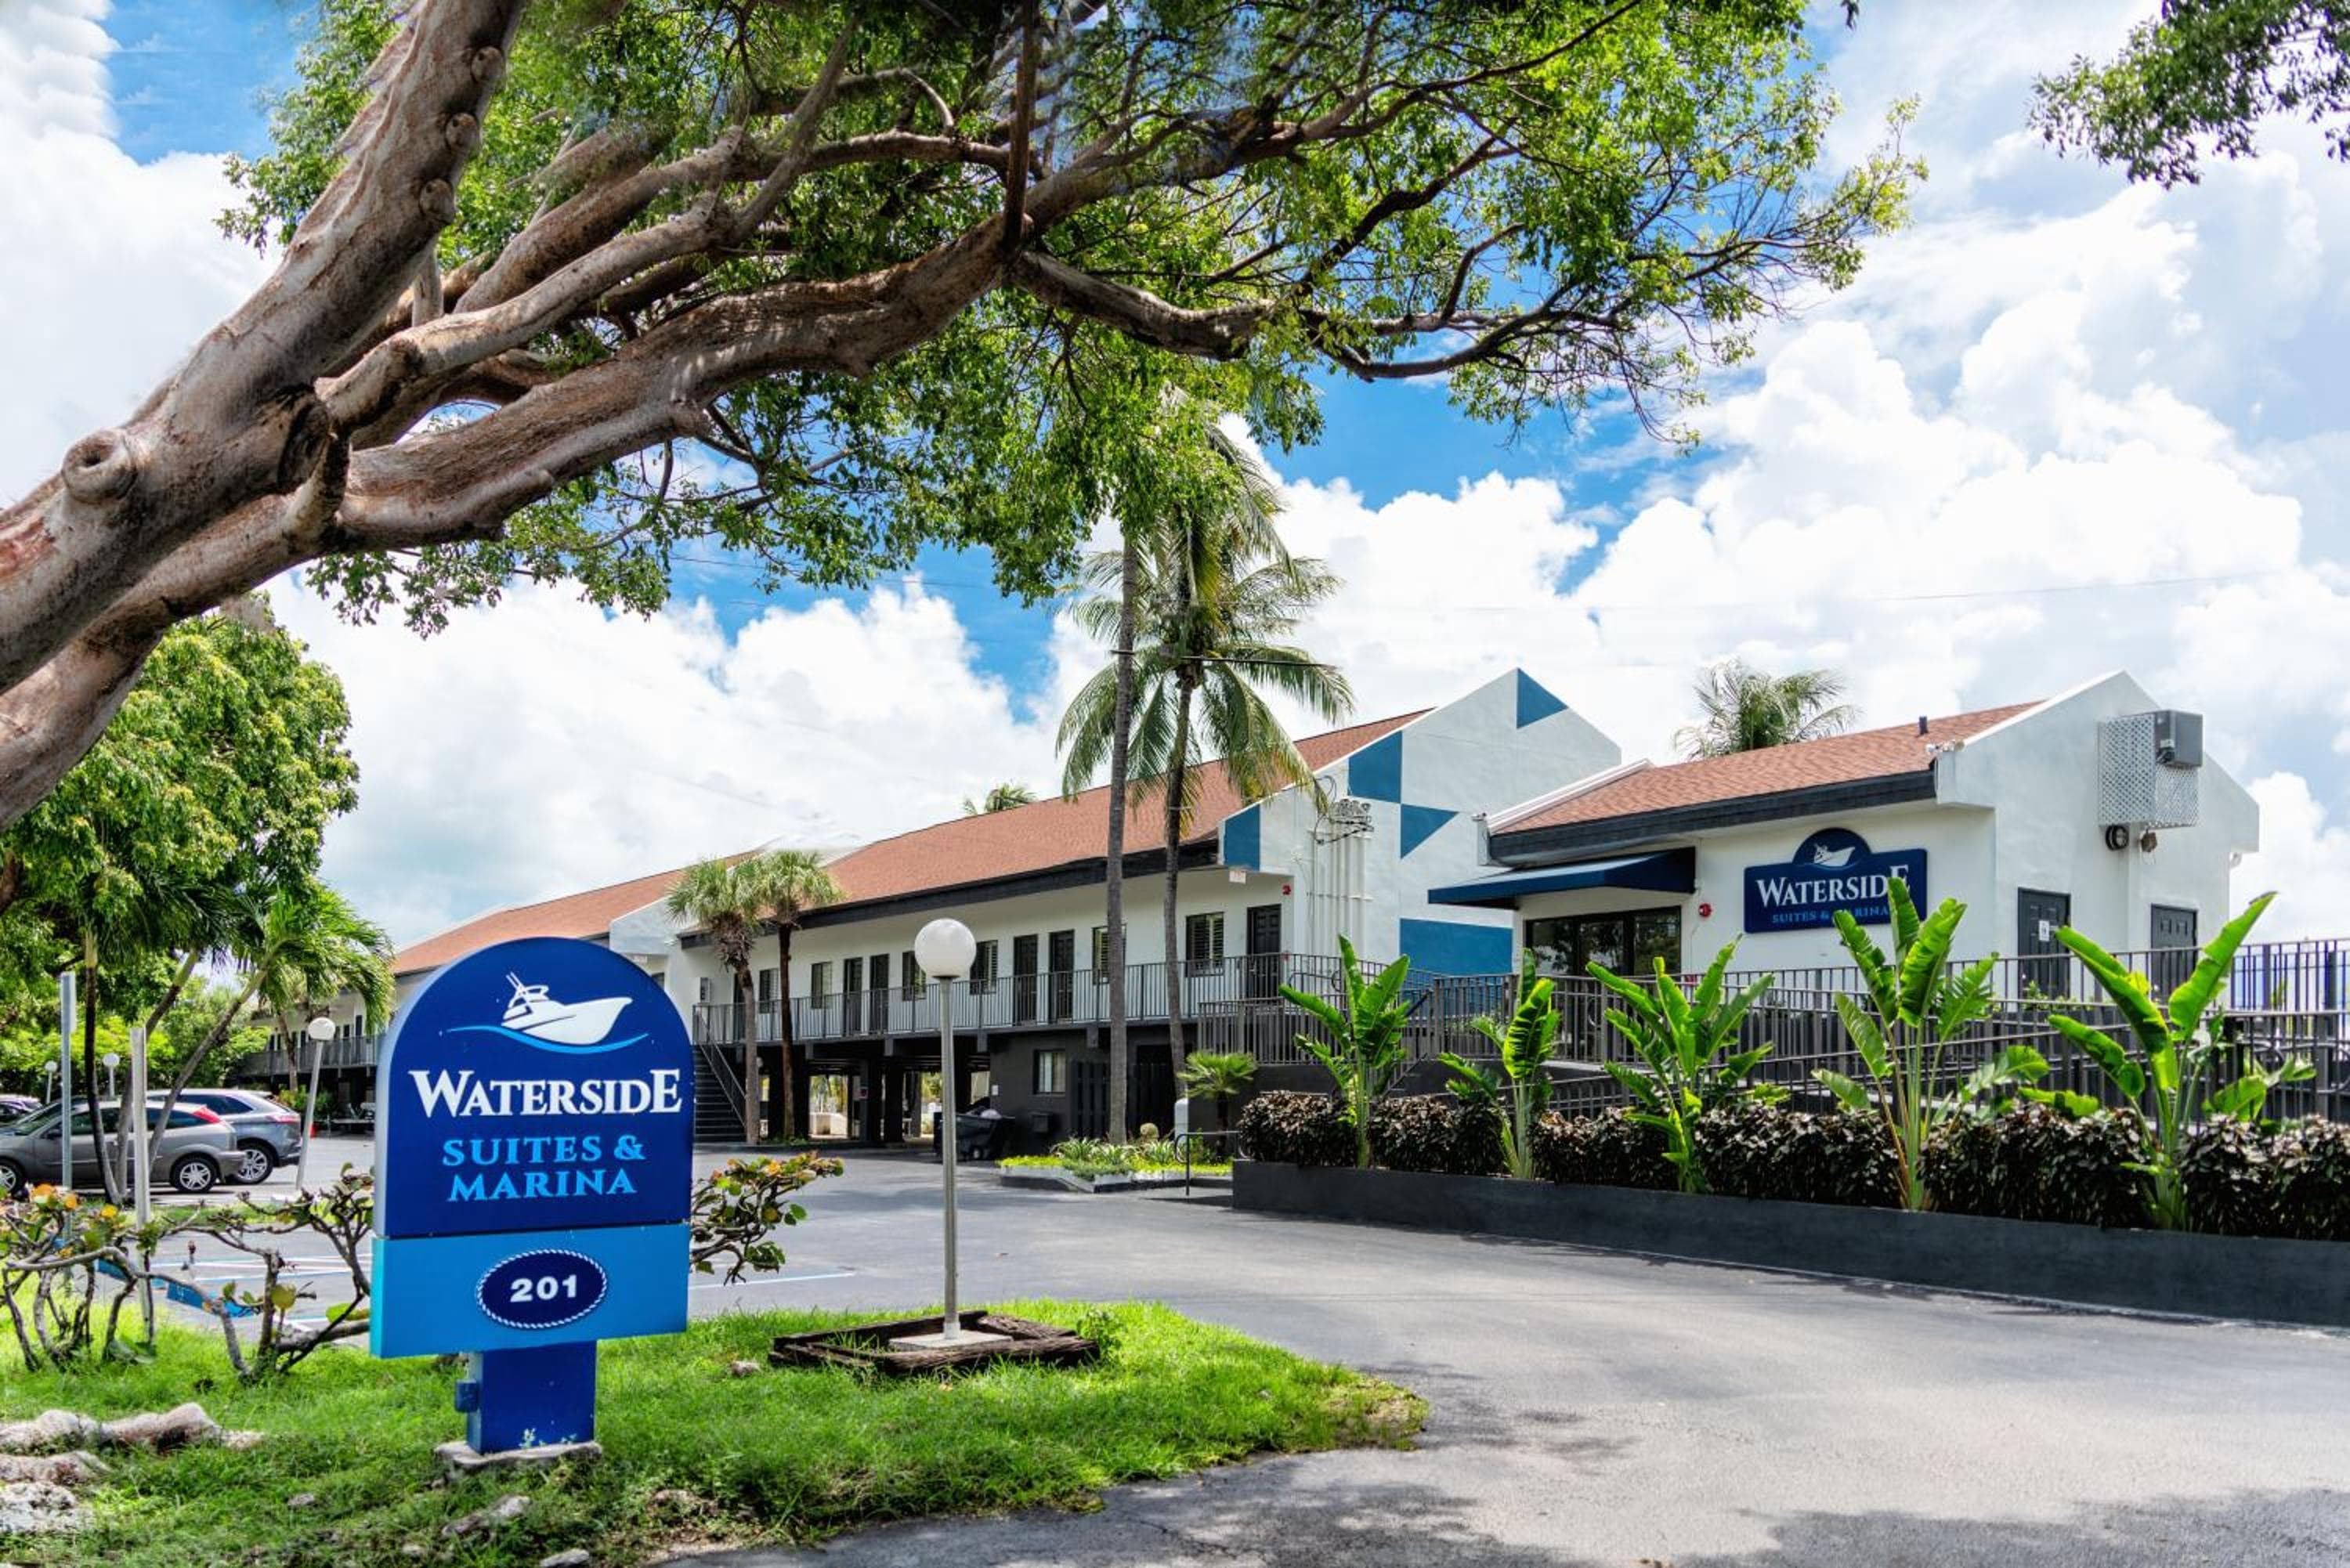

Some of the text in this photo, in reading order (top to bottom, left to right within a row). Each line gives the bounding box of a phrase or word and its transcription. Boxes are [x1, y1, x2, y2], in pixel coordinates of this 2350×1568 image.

[1755, 864, 1911, 908] WATERSIDE
[1772, 905, 1889, 923] SUITES & RINA
[408, 1068, 682, 1118] WATERSIDE
[442, 1134, 646, 1167] SUITES &
[447, 1168, 638, 1202] MARINA
[509, 1274, 578, 1302] 201
